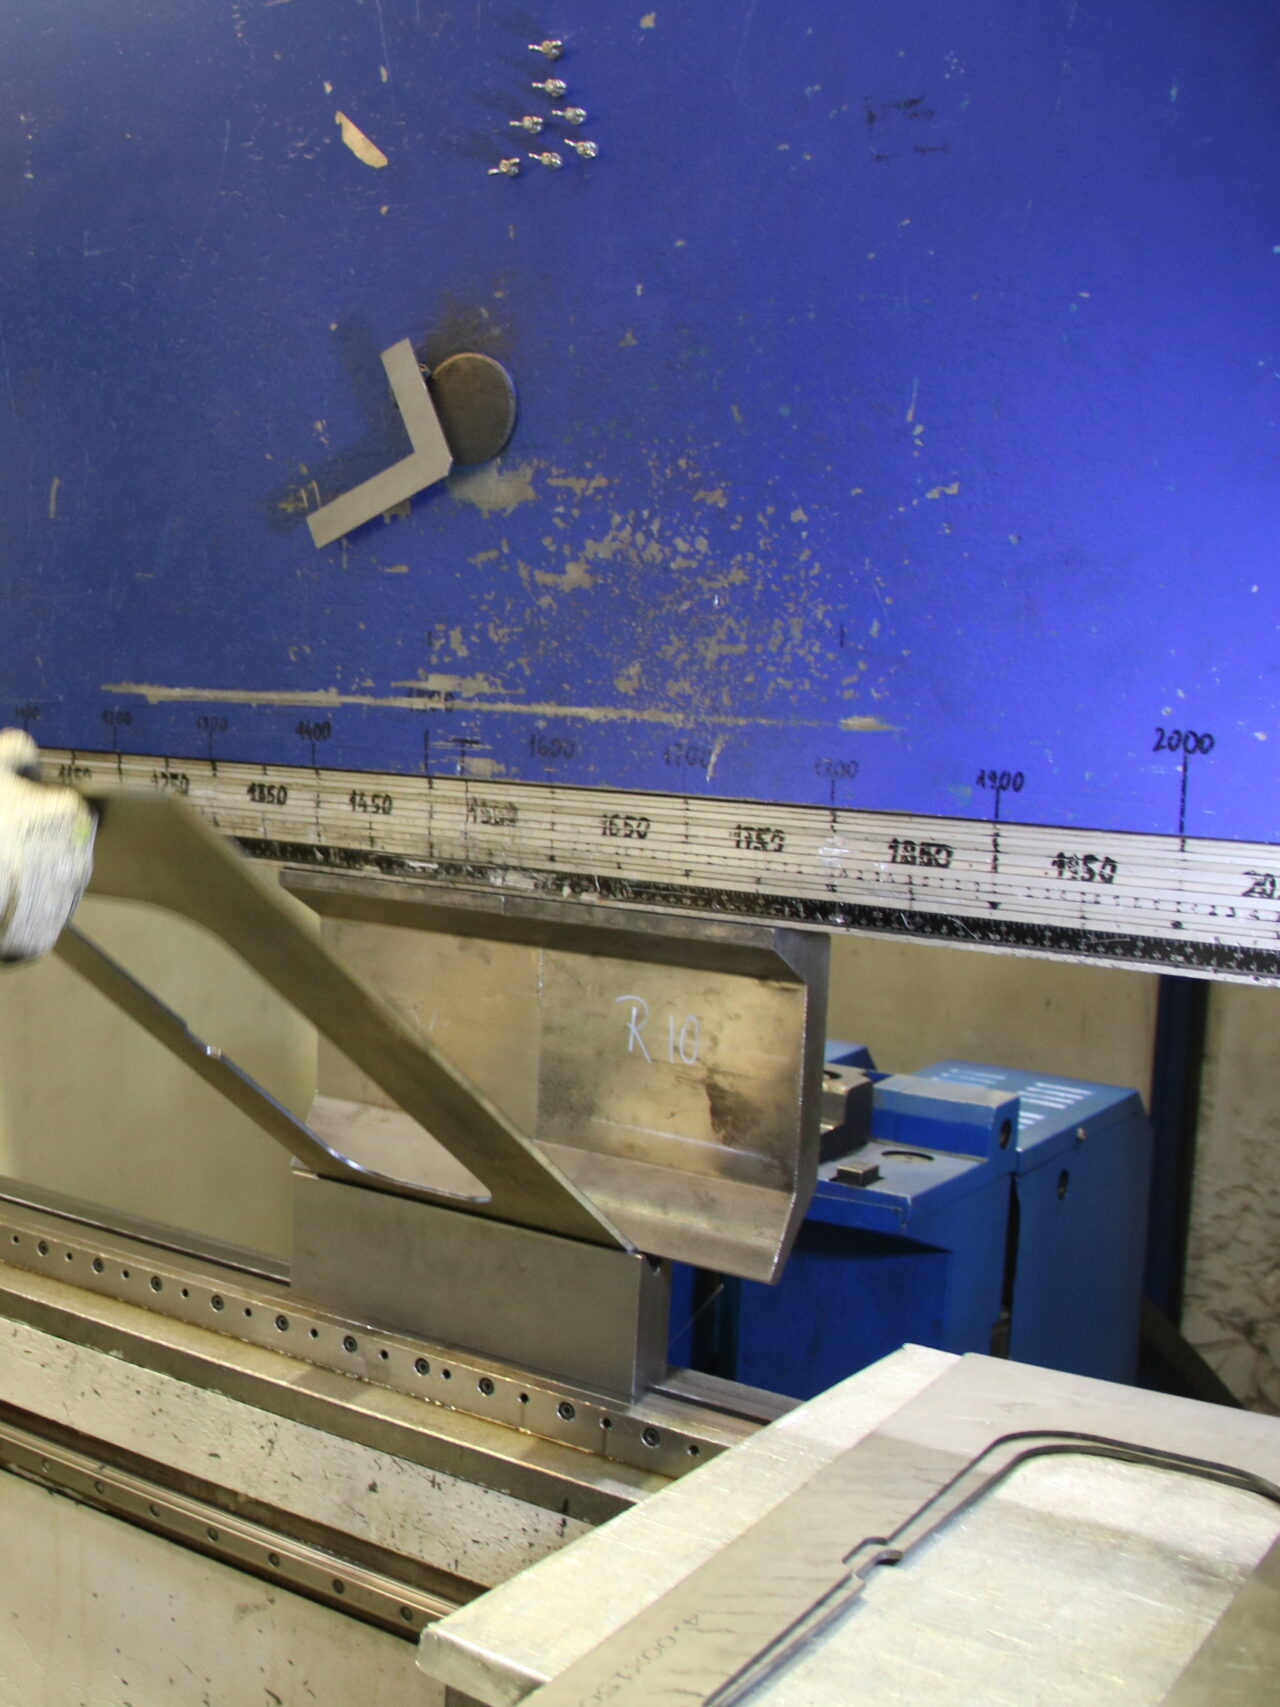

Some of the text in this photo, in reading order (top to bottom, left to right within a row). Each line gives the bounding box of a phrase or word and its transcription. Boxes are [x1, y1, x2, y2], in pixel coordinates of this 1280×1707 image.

[296, 720, 332, 740] 1400
[1153, 727, 1216, 755] 2000
[976, 769, 1025, 792] 1900
[349, 789, 393, 815] 1450
[601, 814, 651, 840] 1650
[1241, 870, 1280, 899] 20
[615, 995, 701, 1065] R 10
